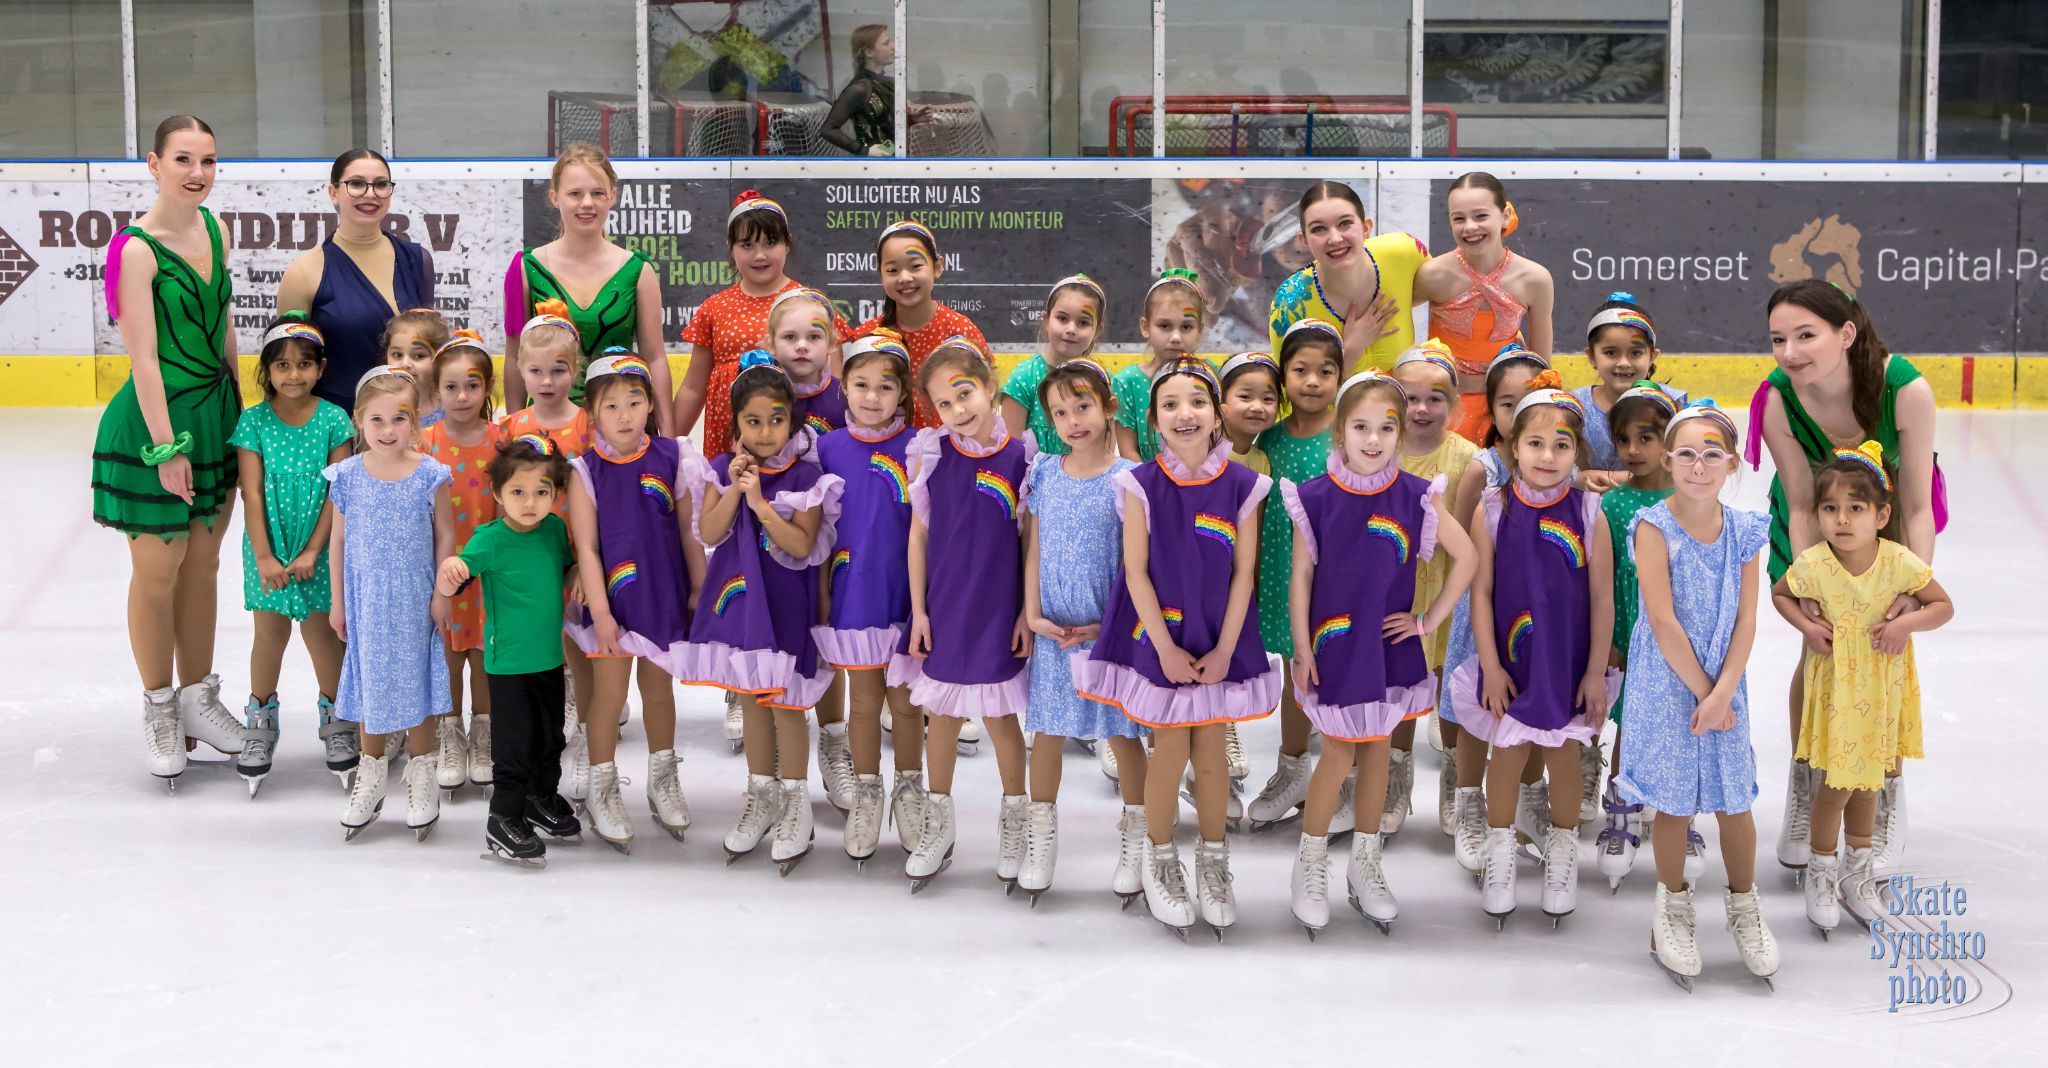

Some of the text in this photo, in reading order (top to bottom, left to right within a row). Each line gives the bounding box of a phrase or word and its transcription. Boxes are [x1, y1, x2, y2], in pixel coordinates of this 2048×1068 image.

[619, 183, 672, 209] ALLE
[826, 185, 981, 204] SOLLICITEER NU ALS
[604, 210, 692, 235] RIJHEID
[826, 210, 1063, 229] SAFETY EN SECURITY MONTEUR
[1571, 247, 1750, 282] Somerset
[1877, 247, 2001, 290] Capital
